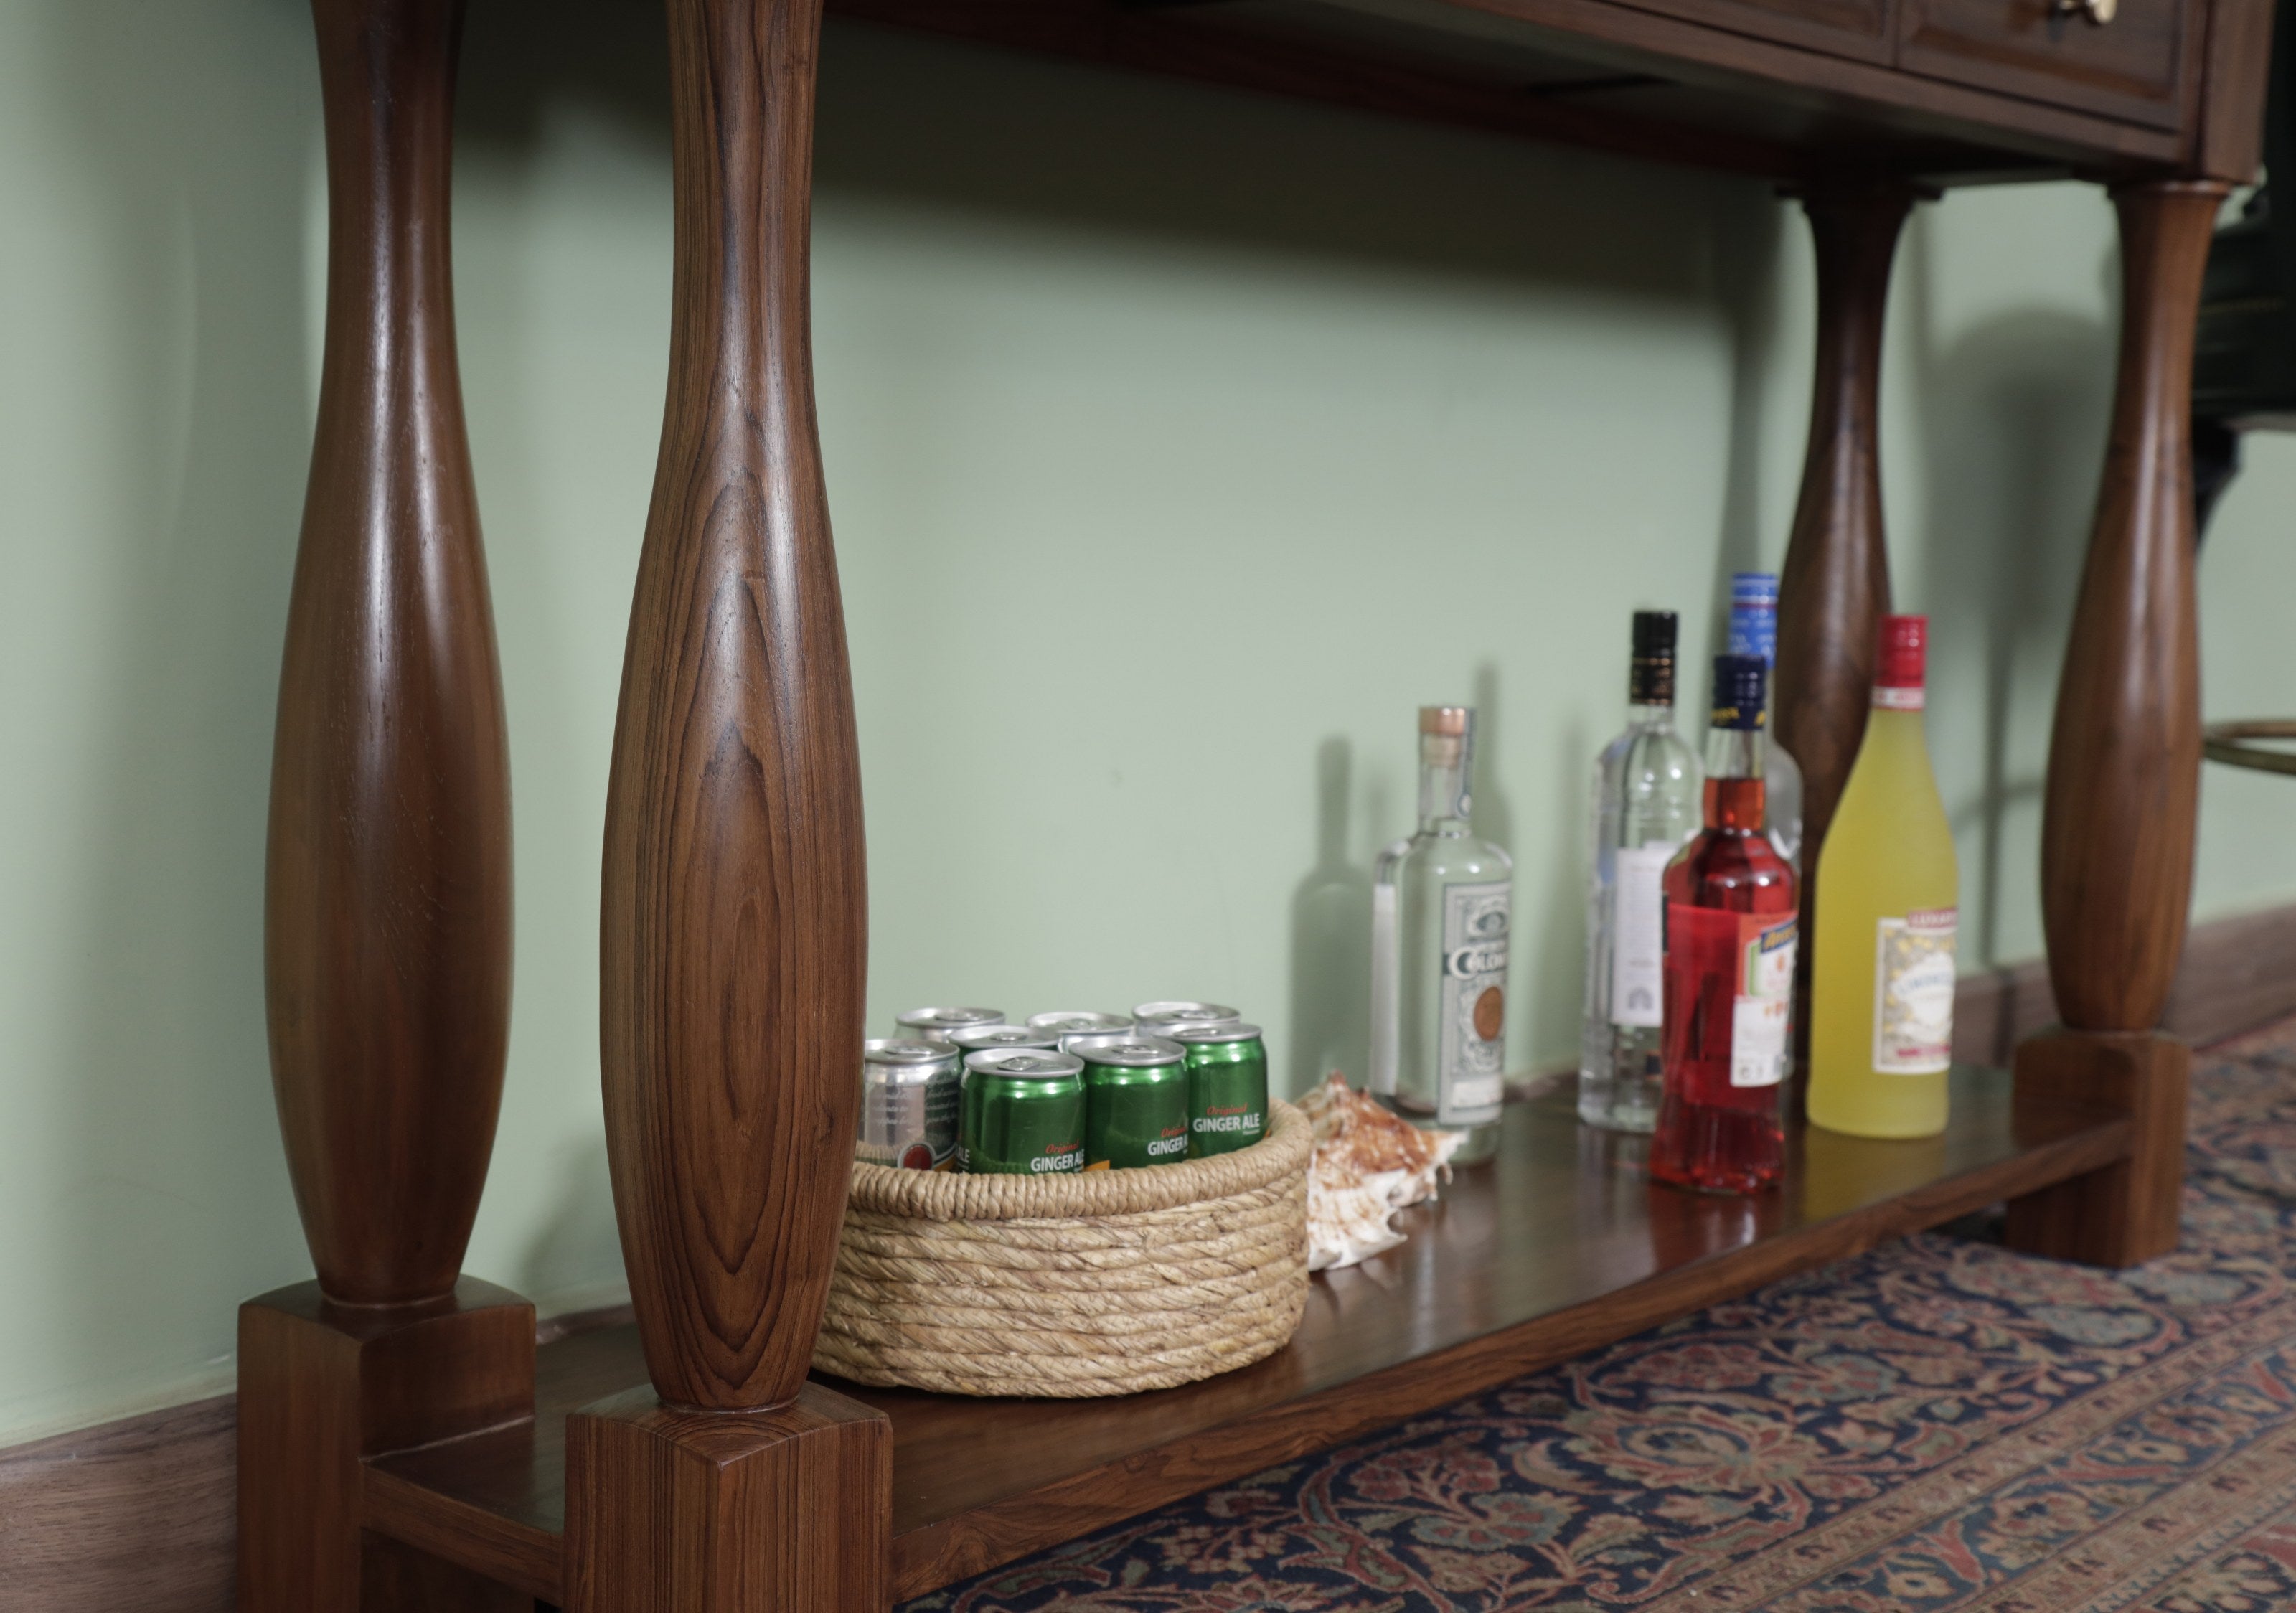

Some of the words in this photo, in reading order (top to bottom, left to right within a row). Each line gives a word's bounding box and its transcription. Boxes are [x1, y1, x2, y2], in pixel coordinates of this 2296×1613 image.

[1206, 1102, 1248, 1116] Original
[1192, 1116, 1241, 1133] GINGER
[1242, 1113, 1260, 1129] ALE
[1147, 1135, 1184, 1156] GINGER
[1030, 1153, 1073, 1172] GINGER
